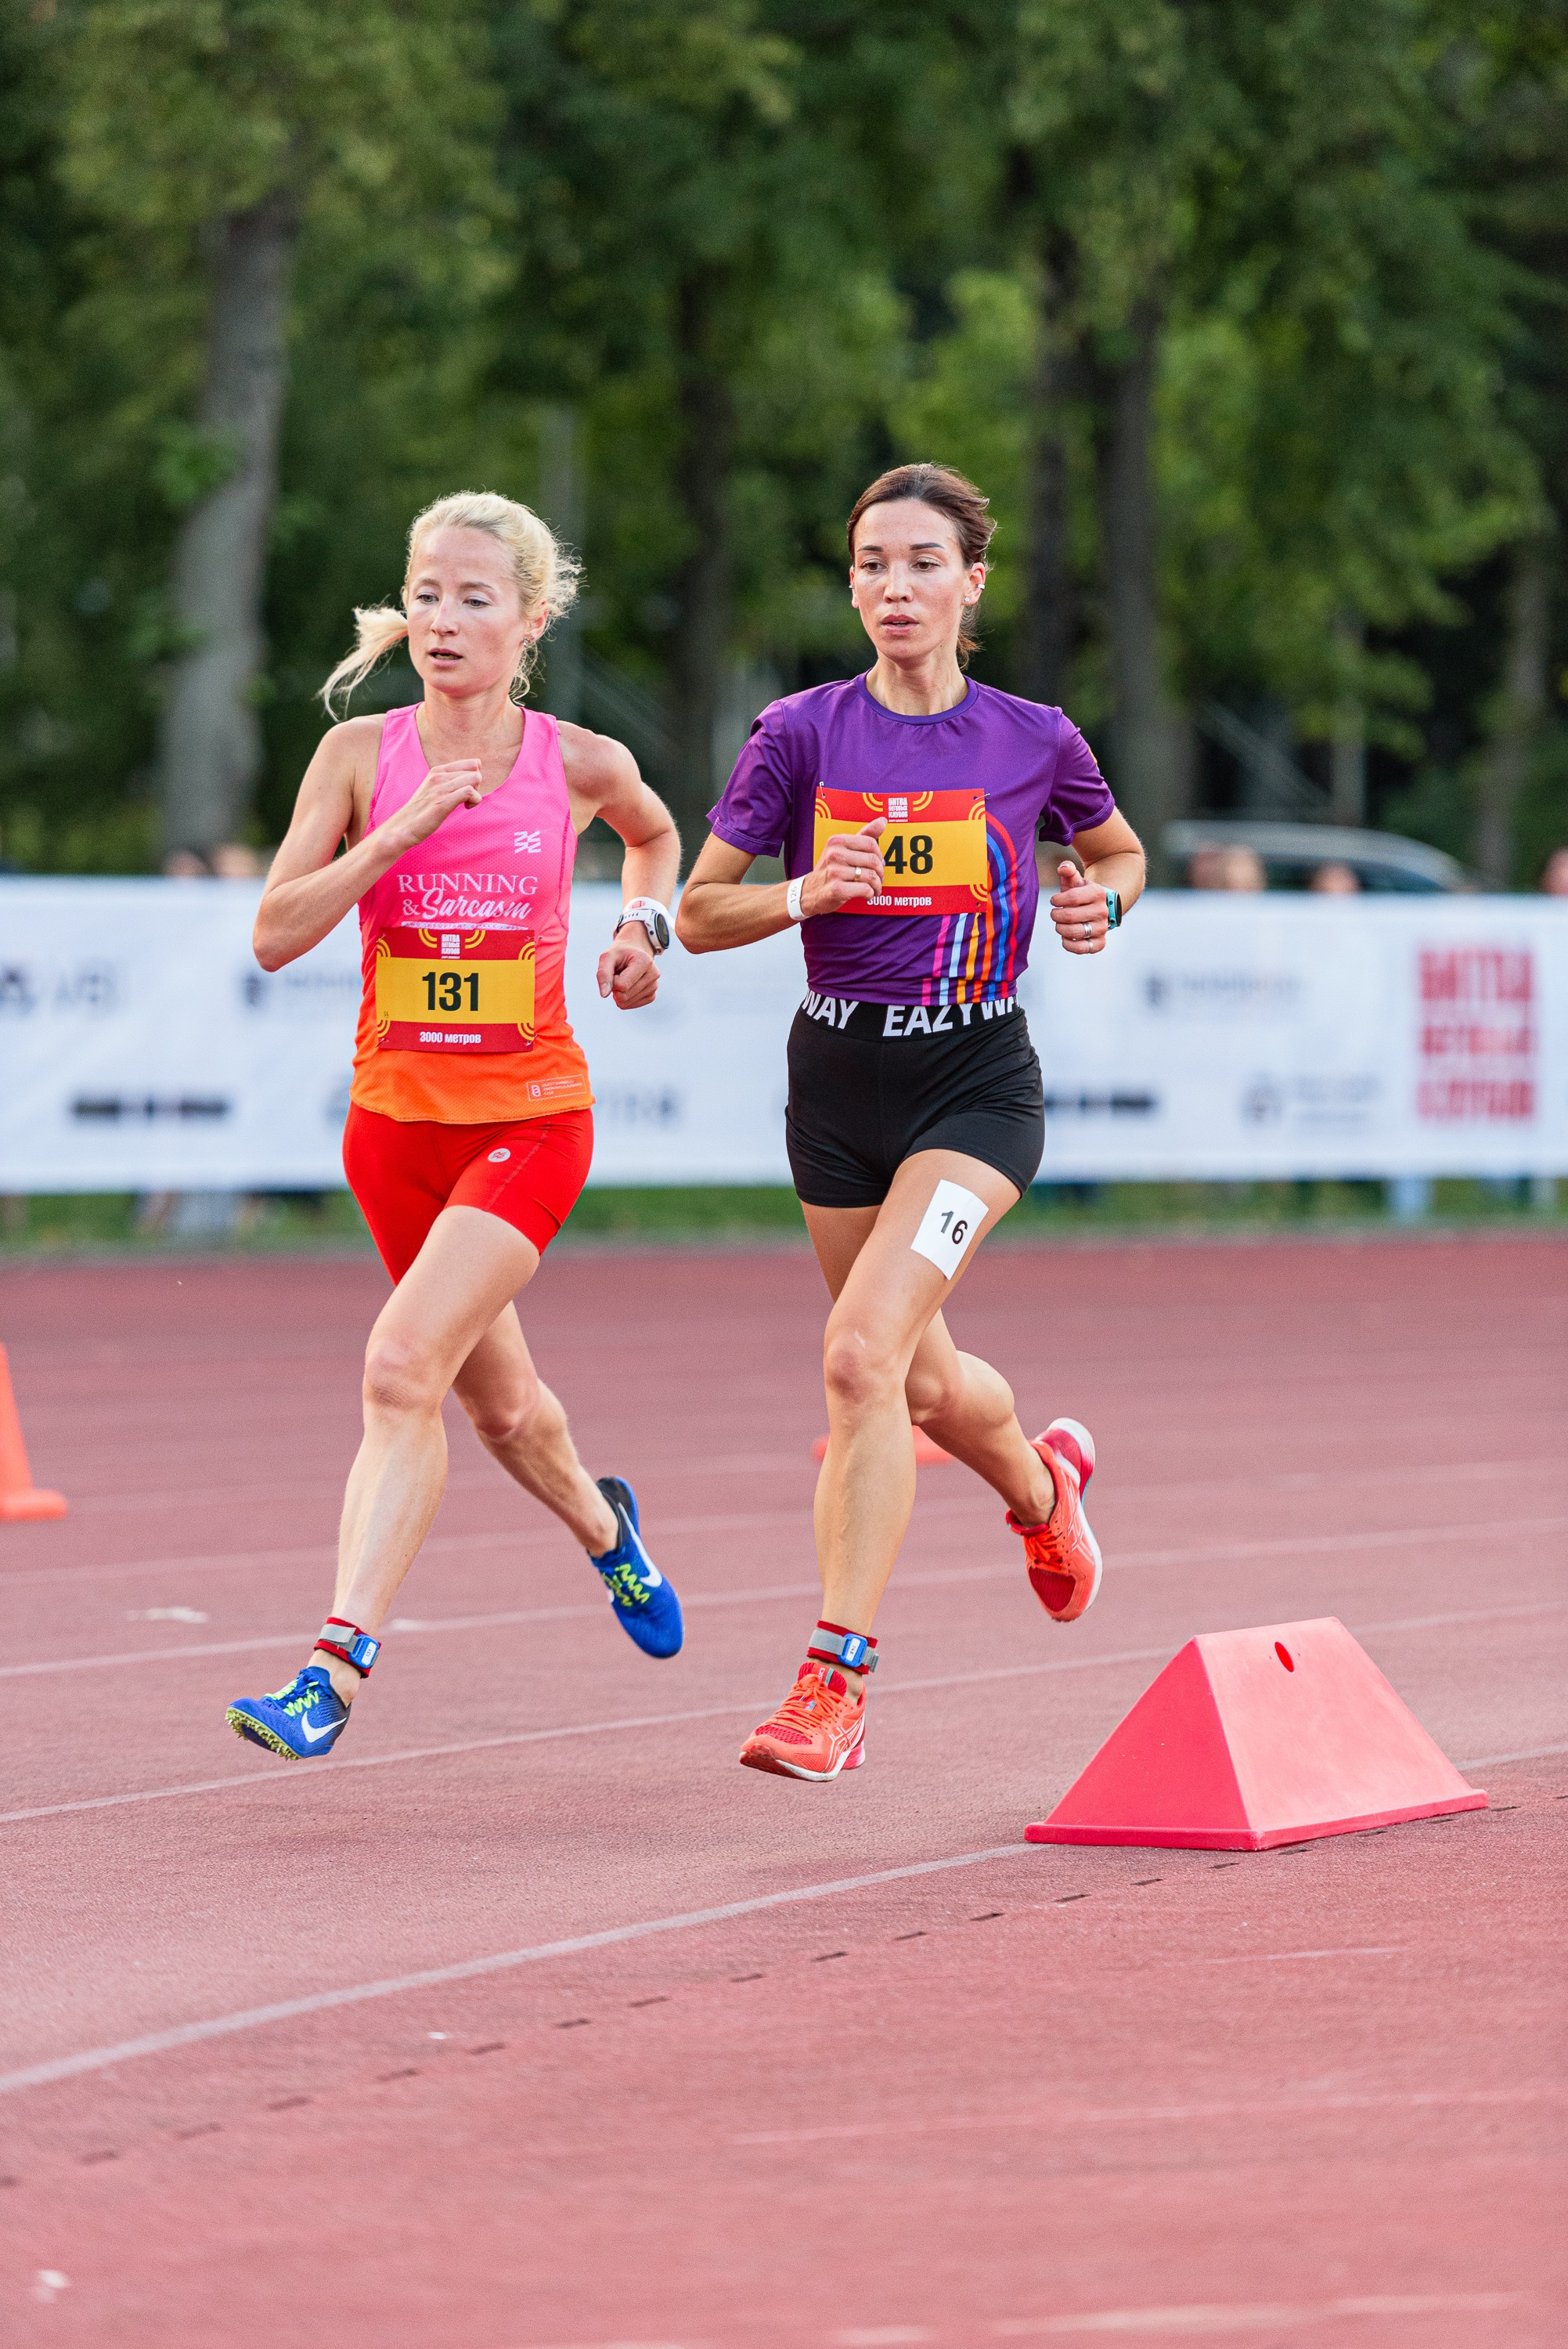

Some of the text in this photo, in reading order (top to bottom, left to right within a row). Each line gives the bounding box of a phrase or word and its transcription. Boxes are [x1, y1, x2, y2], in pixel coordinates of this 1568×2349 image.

[876, 835, 933, 875] 48
[397, 873, 538, 895] RUNNING
[894, 897, 932, 908] метров
[422, 972, 479, 1011] 131
[420, 1031, 482, 1046] 3000 метров
[940, 1210, 968, 1245] 16
